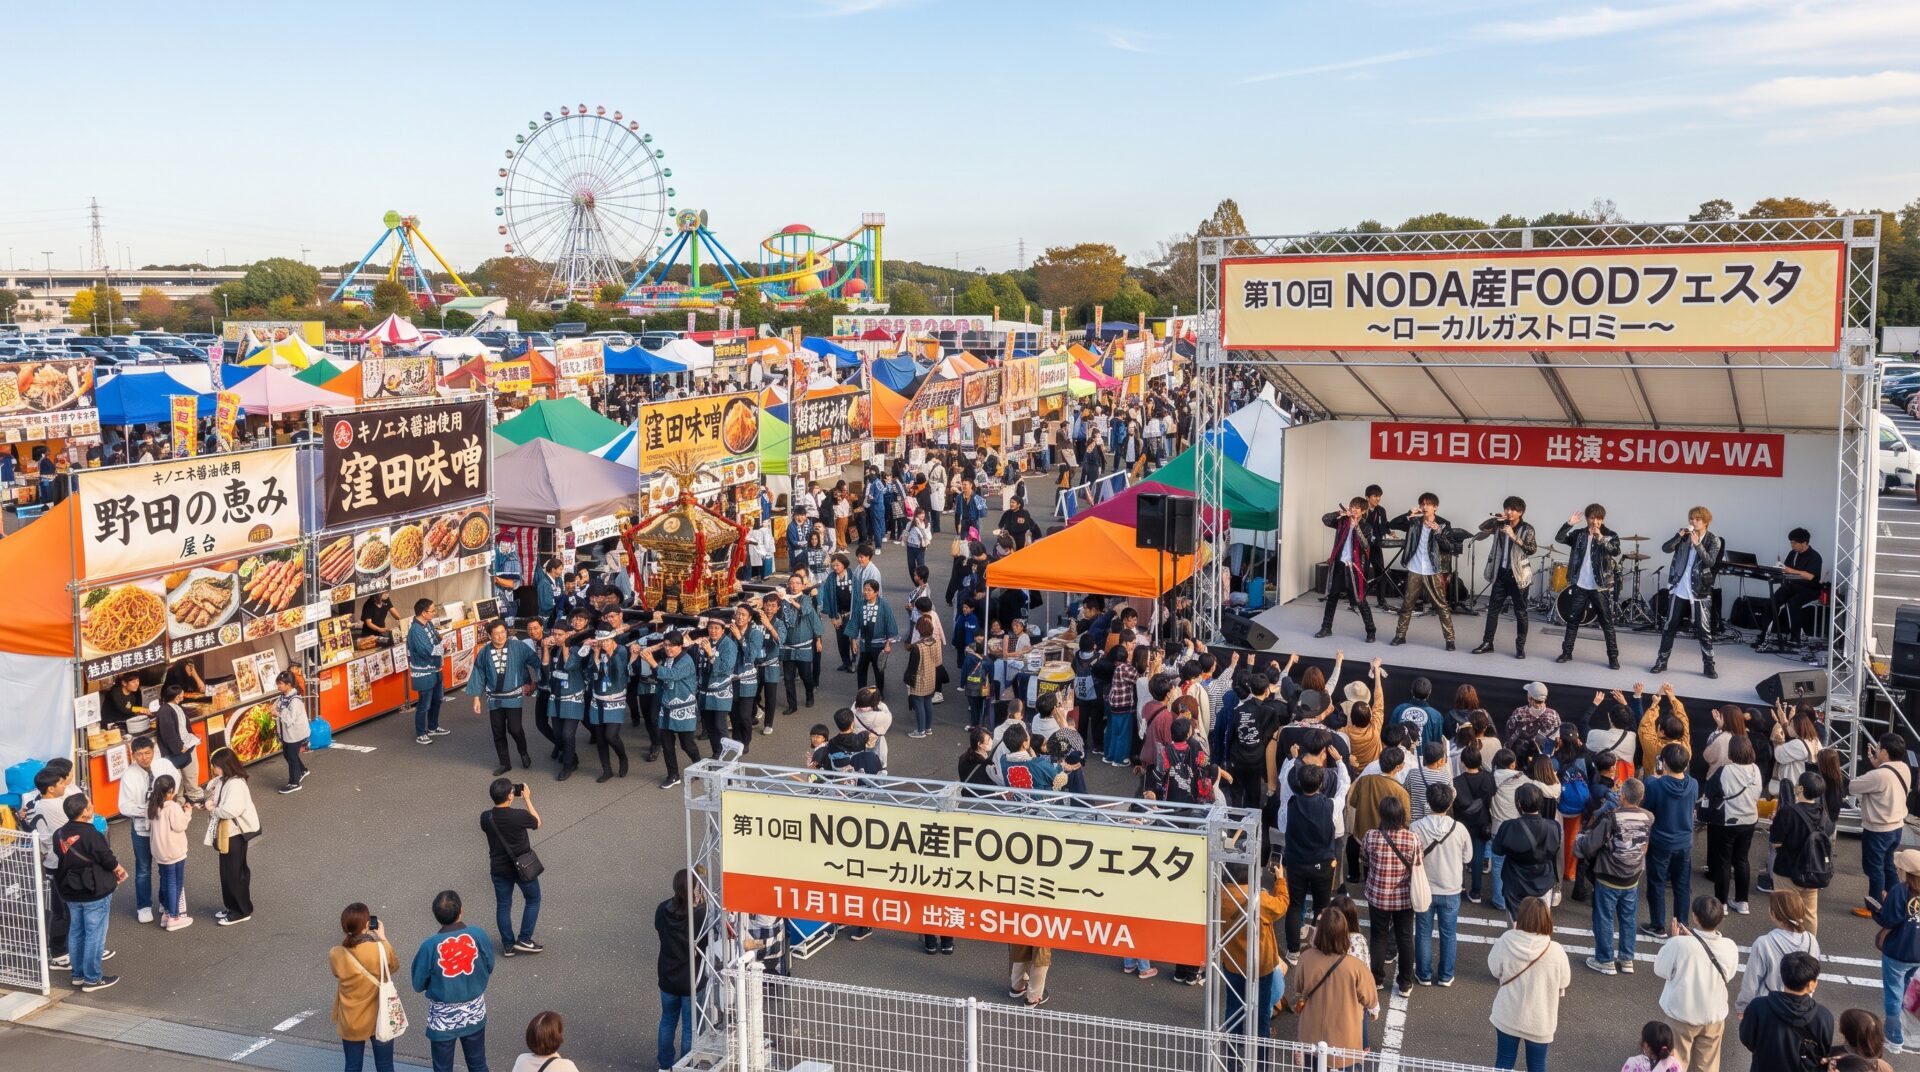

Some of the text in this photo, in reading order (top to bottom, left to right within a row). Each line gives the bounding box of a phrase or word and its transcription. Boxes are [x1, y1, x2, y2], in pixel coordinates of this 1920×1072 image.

[1244, 260, 1802, 309] 第10回 NODA産FOODフェスタ
[358, 411, 462, 444] キノエネ醤油使用
[340, 434, 483, 512] 窪田味噌
[93, 476, 288, 546] 野田の恵み
[179, 534, 217, 559] 屋台
[733, 813, 1194, 882] 第10回 NODA産FOODフェスタ
